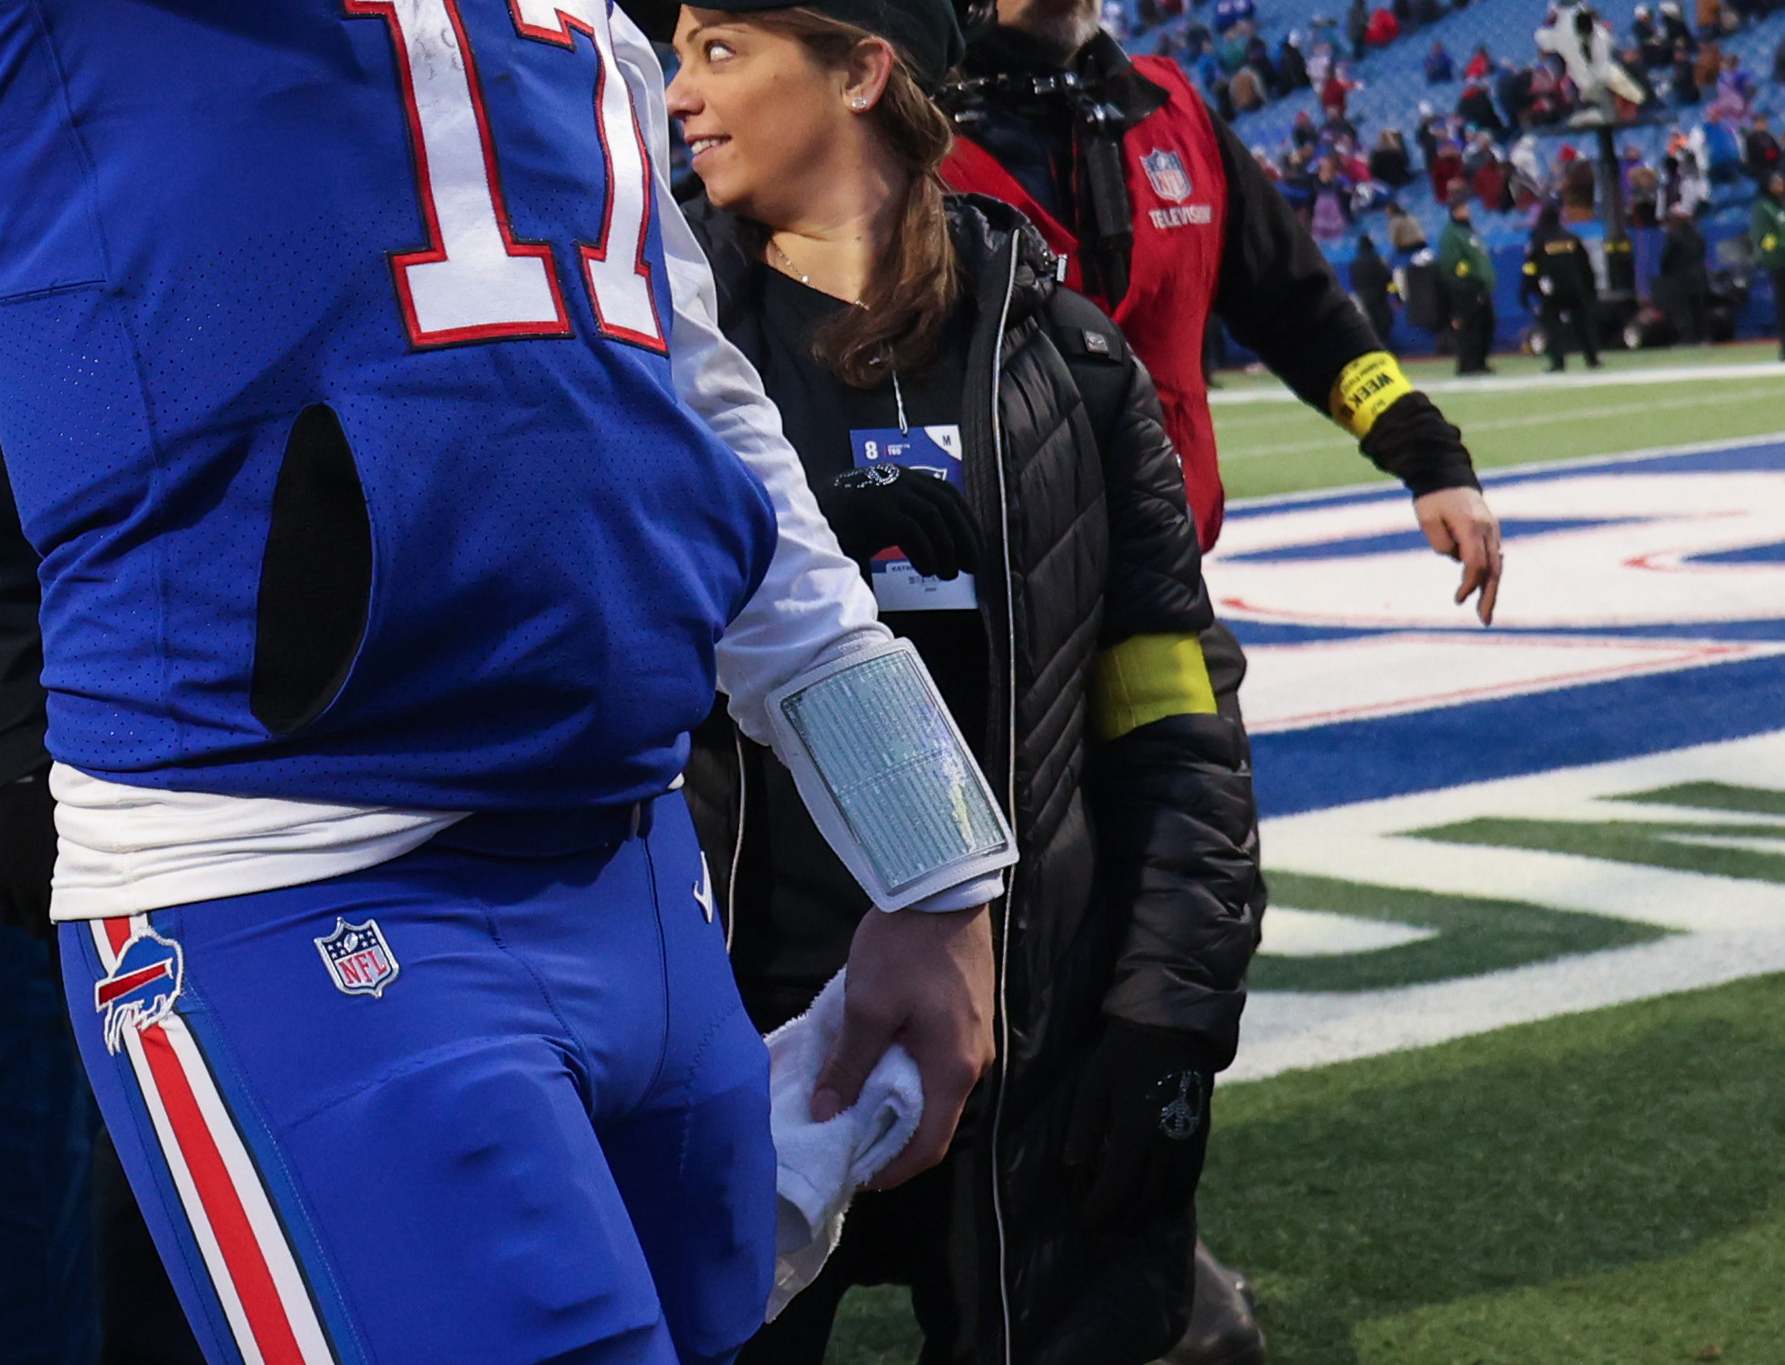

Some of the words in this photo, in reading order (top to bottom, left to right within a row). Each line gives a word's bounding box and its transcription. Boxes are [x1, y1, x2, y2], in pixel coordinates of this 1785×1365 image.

[1148, 205, 1213, 229] TELEVISION
[864, 441, 879, 460] 8
[942, 435, 952, 447] M
[337, 949, 389, 985] NFL
